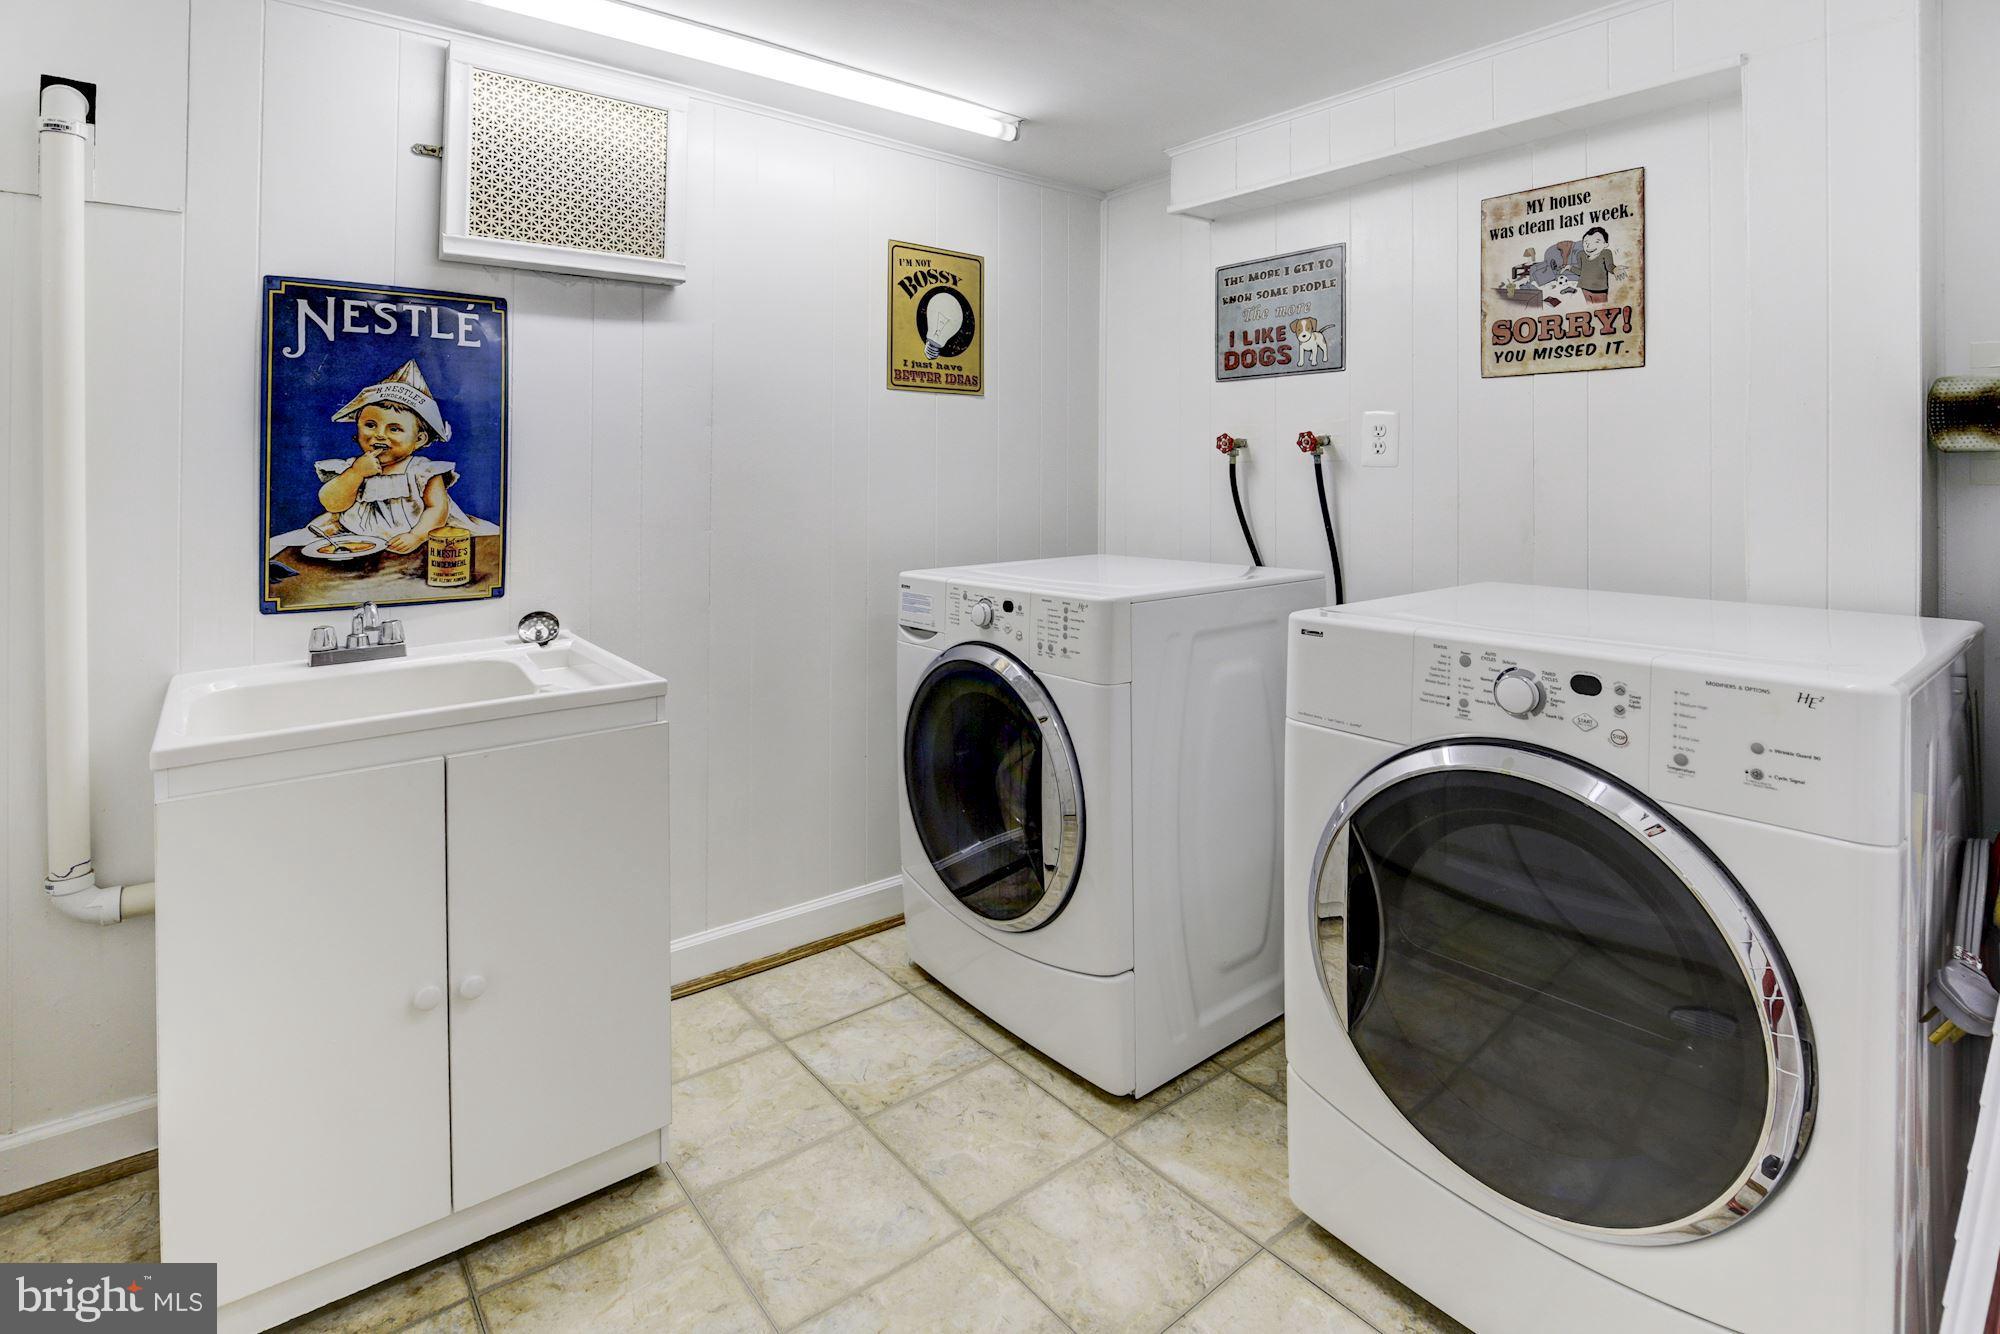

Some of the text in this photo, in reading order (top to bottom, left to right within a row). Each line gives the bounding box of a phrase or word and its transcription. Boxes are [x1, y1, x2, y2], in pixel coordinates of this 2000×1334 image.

[1526, 190, 1591, 215] MY house
[1489, 203, 1634, 241] was clean last week.
[899, 258, 932, 268] I'M NOT
[1224, 259, 1333, 287] THE MORE I GET TO
[897, 268, 962, 300] BOSSY
[1222, 279, 1337, 306] KNOW SOME PEOPLE
[282, 296, 482, 358] NESTLÉ
[1229, 325, 1287, 348] I LIKE
[1491, 305, 1632, 346] SORRY!
[1224, 344, 1292, 371] DOGS
[1494, 340, 1630, 363] YOU MISSED IT.
[894, 369, 979, 387] BETTER IDEAS
[911, 360, 933, 369] just
[936, 361, 963, 371] have
